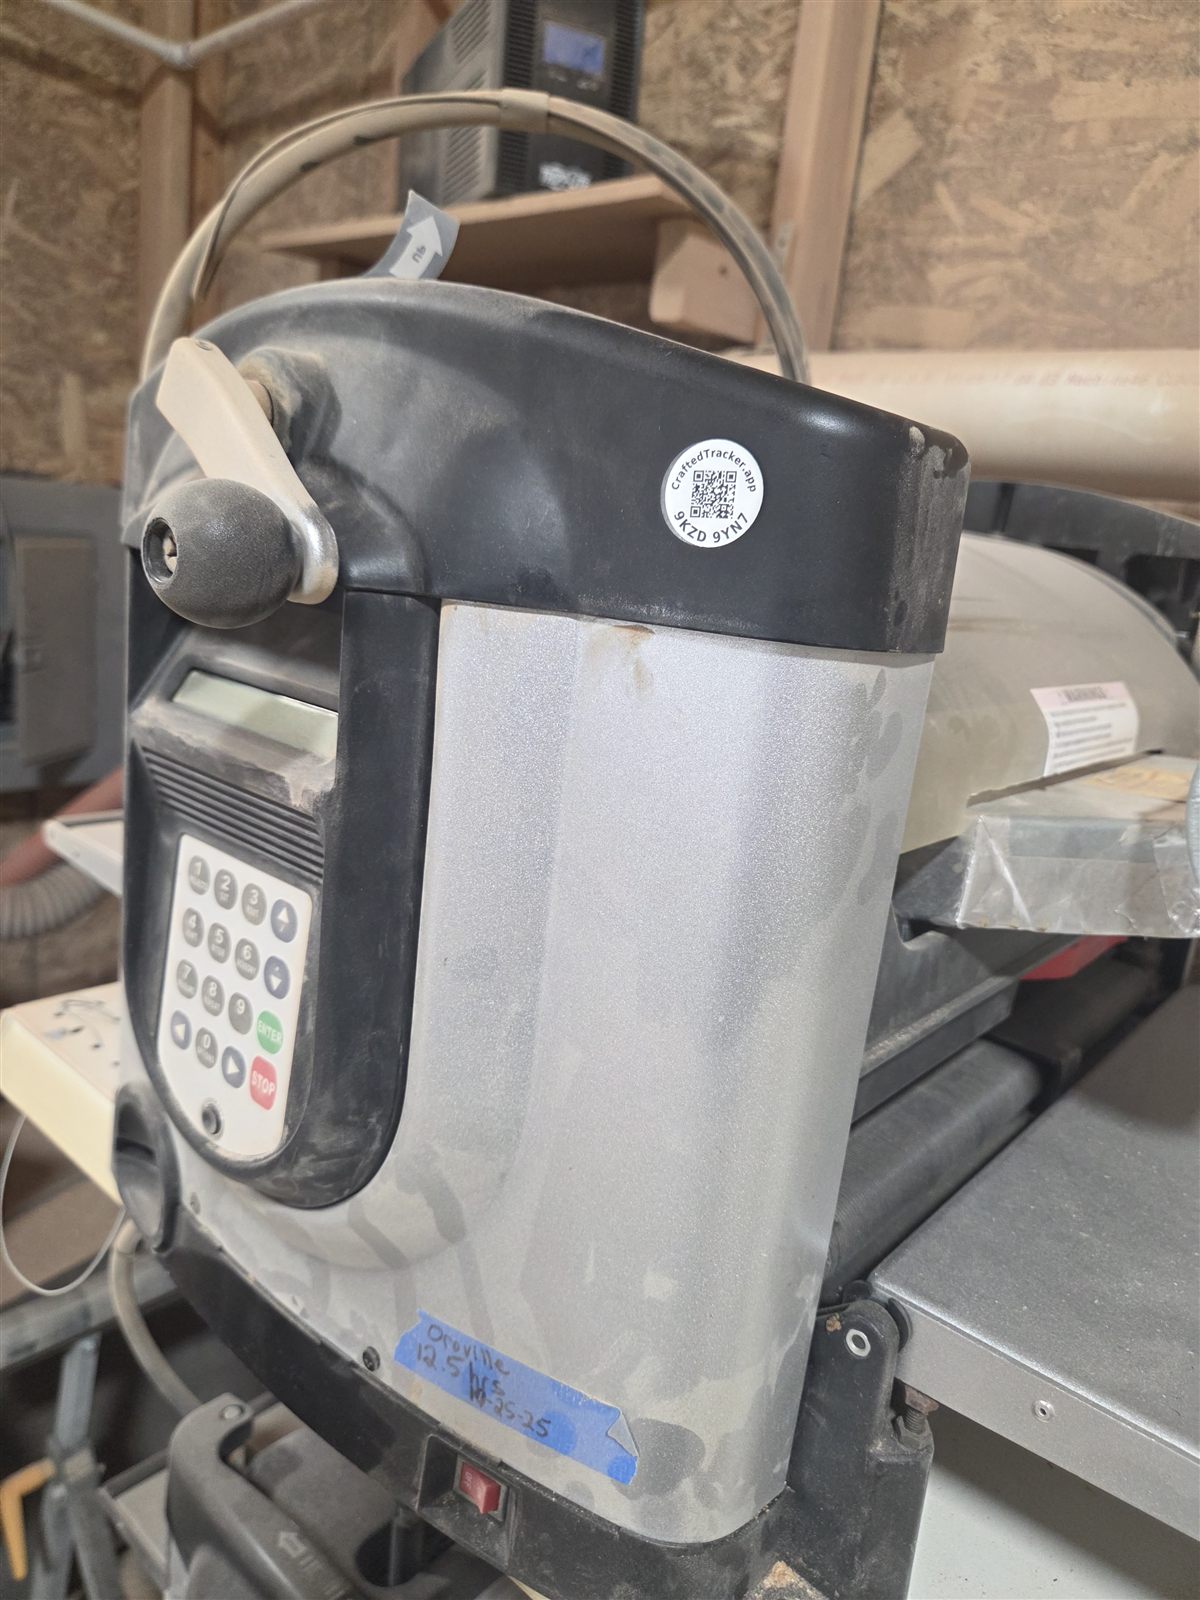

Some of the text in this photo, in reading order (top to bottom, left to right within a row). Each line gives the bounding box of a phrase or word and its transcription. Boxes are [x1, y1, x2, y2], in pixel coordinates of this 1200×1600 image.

[671, 448, 757, 493] CraftedTracker.app
[674, 510, 748, 543] 9KZD 9YN7
[220, 875, 231, 891] 2
[249, 888, 259, 905] 3
[188, 913, 198, 929] 4
[214, 928, 225, 944] 5
[243, 944, 253, 960] 6
[183, 963, 193, 980] 7
[208, 981, 218, 997] 8
[236, 998, 246, 1015] 9
[257, 1020, 283, 1044] ENTER
[203, 1034, 276, 1096] 0 STOP
[416, 1343, 465, 1378] 12.5
